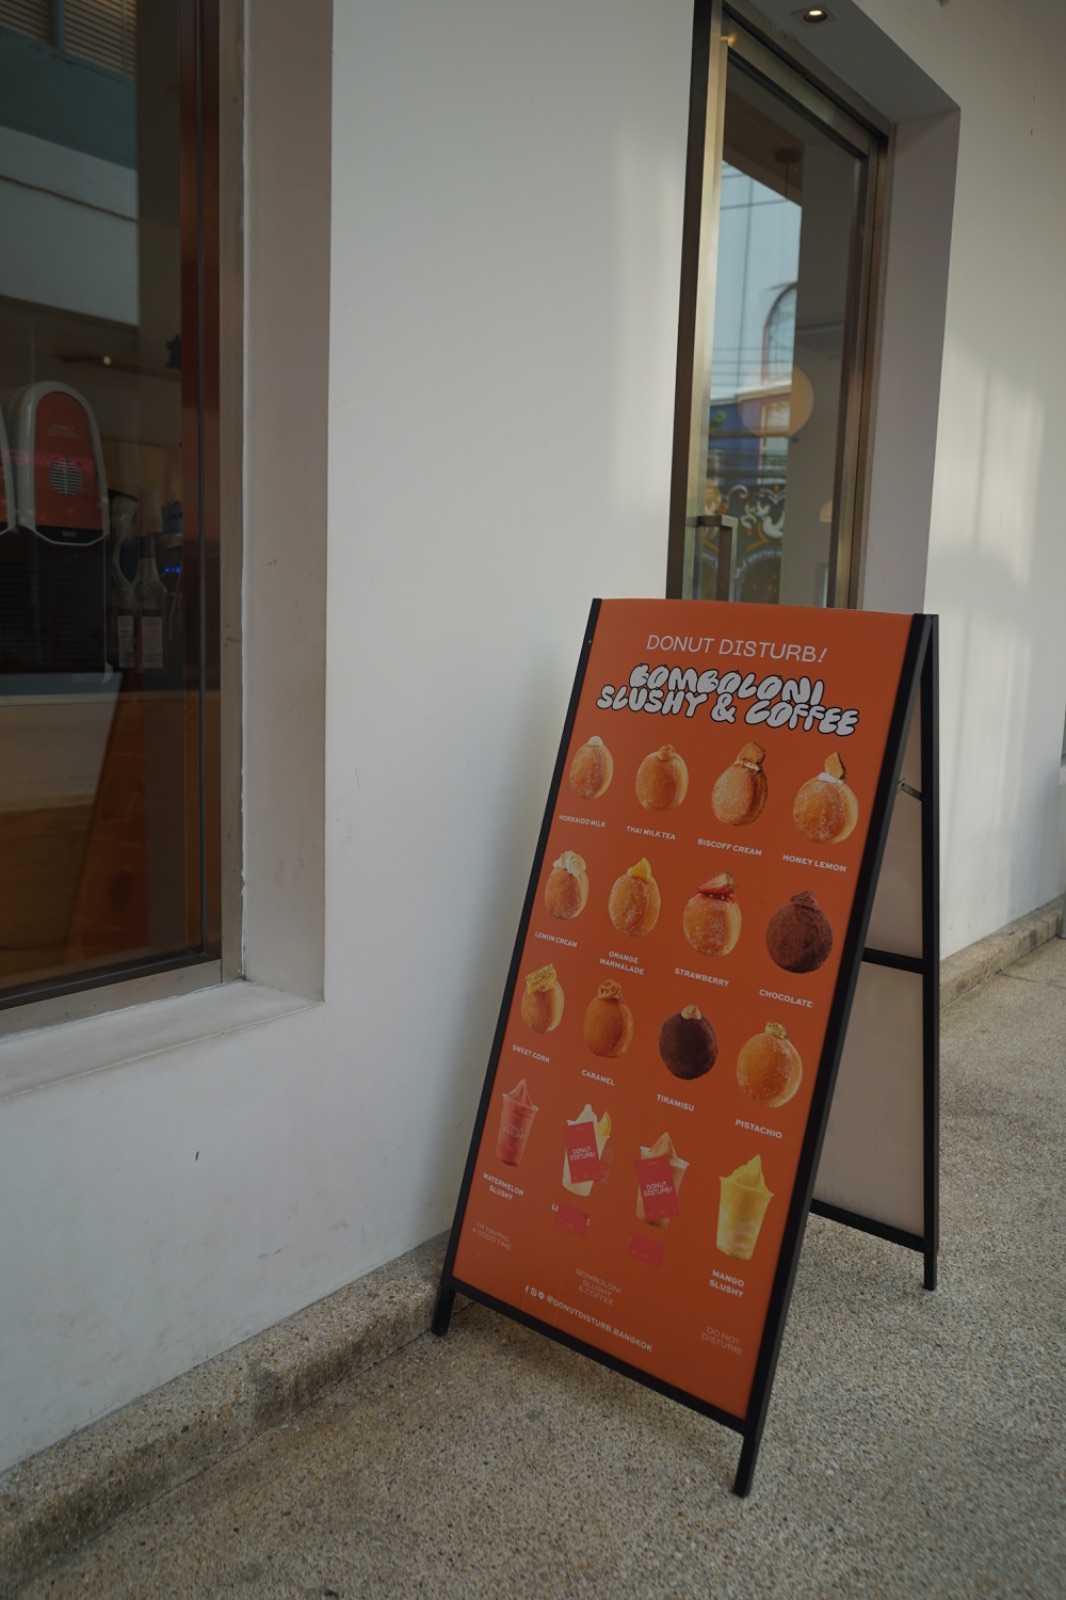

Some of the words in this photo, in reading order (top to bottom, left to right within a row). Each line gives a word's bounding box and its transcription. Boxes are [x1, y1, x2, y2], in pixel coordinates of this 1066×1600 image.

[646, 634, 715, 654] DONUT
[718, 638, 828, 663] DISTURB!
[629, 662, 825, 707] BOMBOLONI
[596, 684, 709, 718] SLUSHY
[710, 692, 737, 723] &
[744, 699, 860, 736] COFFEE
[558, 814, 590, 825] HOKKAIDO
[590, 819, 606, 828] MILK
[626, 825, 642, 834] THAI
[643, 828, 661, 838] MILK
[661, 831, 676, 840] TEA
[697, 838, 732, 850] BISCOFF
[732, 844, 763, 856] CREAM
[782, 854, 813, 866] HONEY
[814, 860, 847, 872] LEMON
[534, 931, 555, 942] LEMON
[555, 936, 578, 948] CREAM
[608, 950, 639, 964] ORANGE
[599, 958, 645, 975] MARMALADE
[674, 967, 730, 987] STRAWBERRY
[759, 989, 814, 1008] CHOCOLATE
[512, 1044, 532, 1056] SWEET
[532, 1052, 551, 1064] CORN
[581, 1069, 615, 1086] CARAMEL
[656, 1094, 695, 1112] TIRAMISU
[735, 1119, 783, 1139] PISTACHIO
[483, 1171, 525, 1197] WATERMELON
[489, 1184, 513, 1200] SLUSHY
[646, 1181, 667, 1191] DONUT
[477, 1229, 497, 1243] GOOD
[712, 1269, 745, 1288] MANGO
[709, 1279, 744, 1298] SLUSHY
[546, 1294, 653, 1352] @DONUTDISTURB.BANGKOK
[706, 1326, 721, 1337] DO
[721, 1332, 741, 1345] NOT
